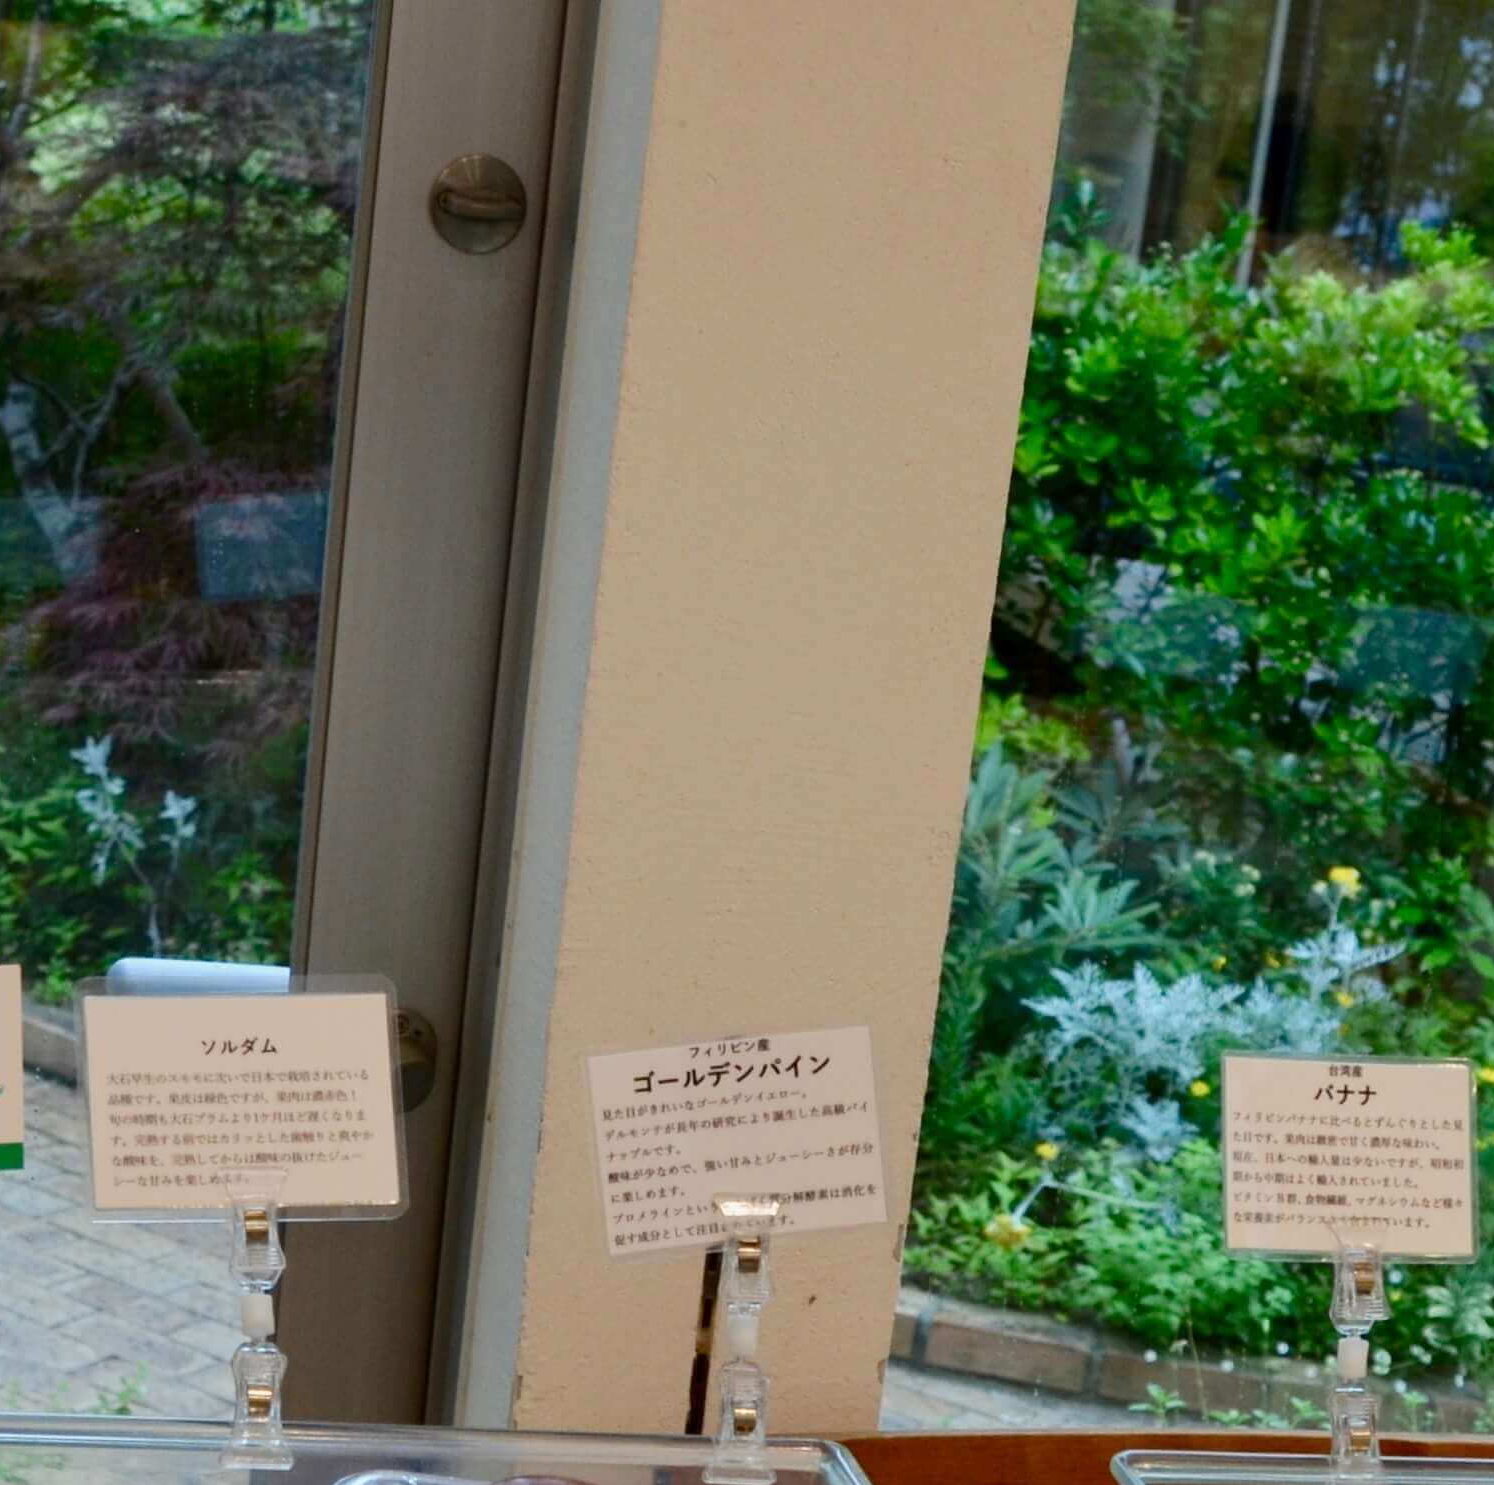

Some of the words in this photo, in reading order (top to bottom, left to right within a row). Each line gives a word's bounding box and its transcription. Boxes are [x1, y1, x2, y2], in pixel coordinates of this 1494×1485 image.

[201, 1037, 277, 1055] ソルダム
[634, 1056, 830, 1093] ゴールデンパイン
[1329, 1065, 1362, 1078] 台湾産
[1315, 1084, 1376, 1105] バナナ
